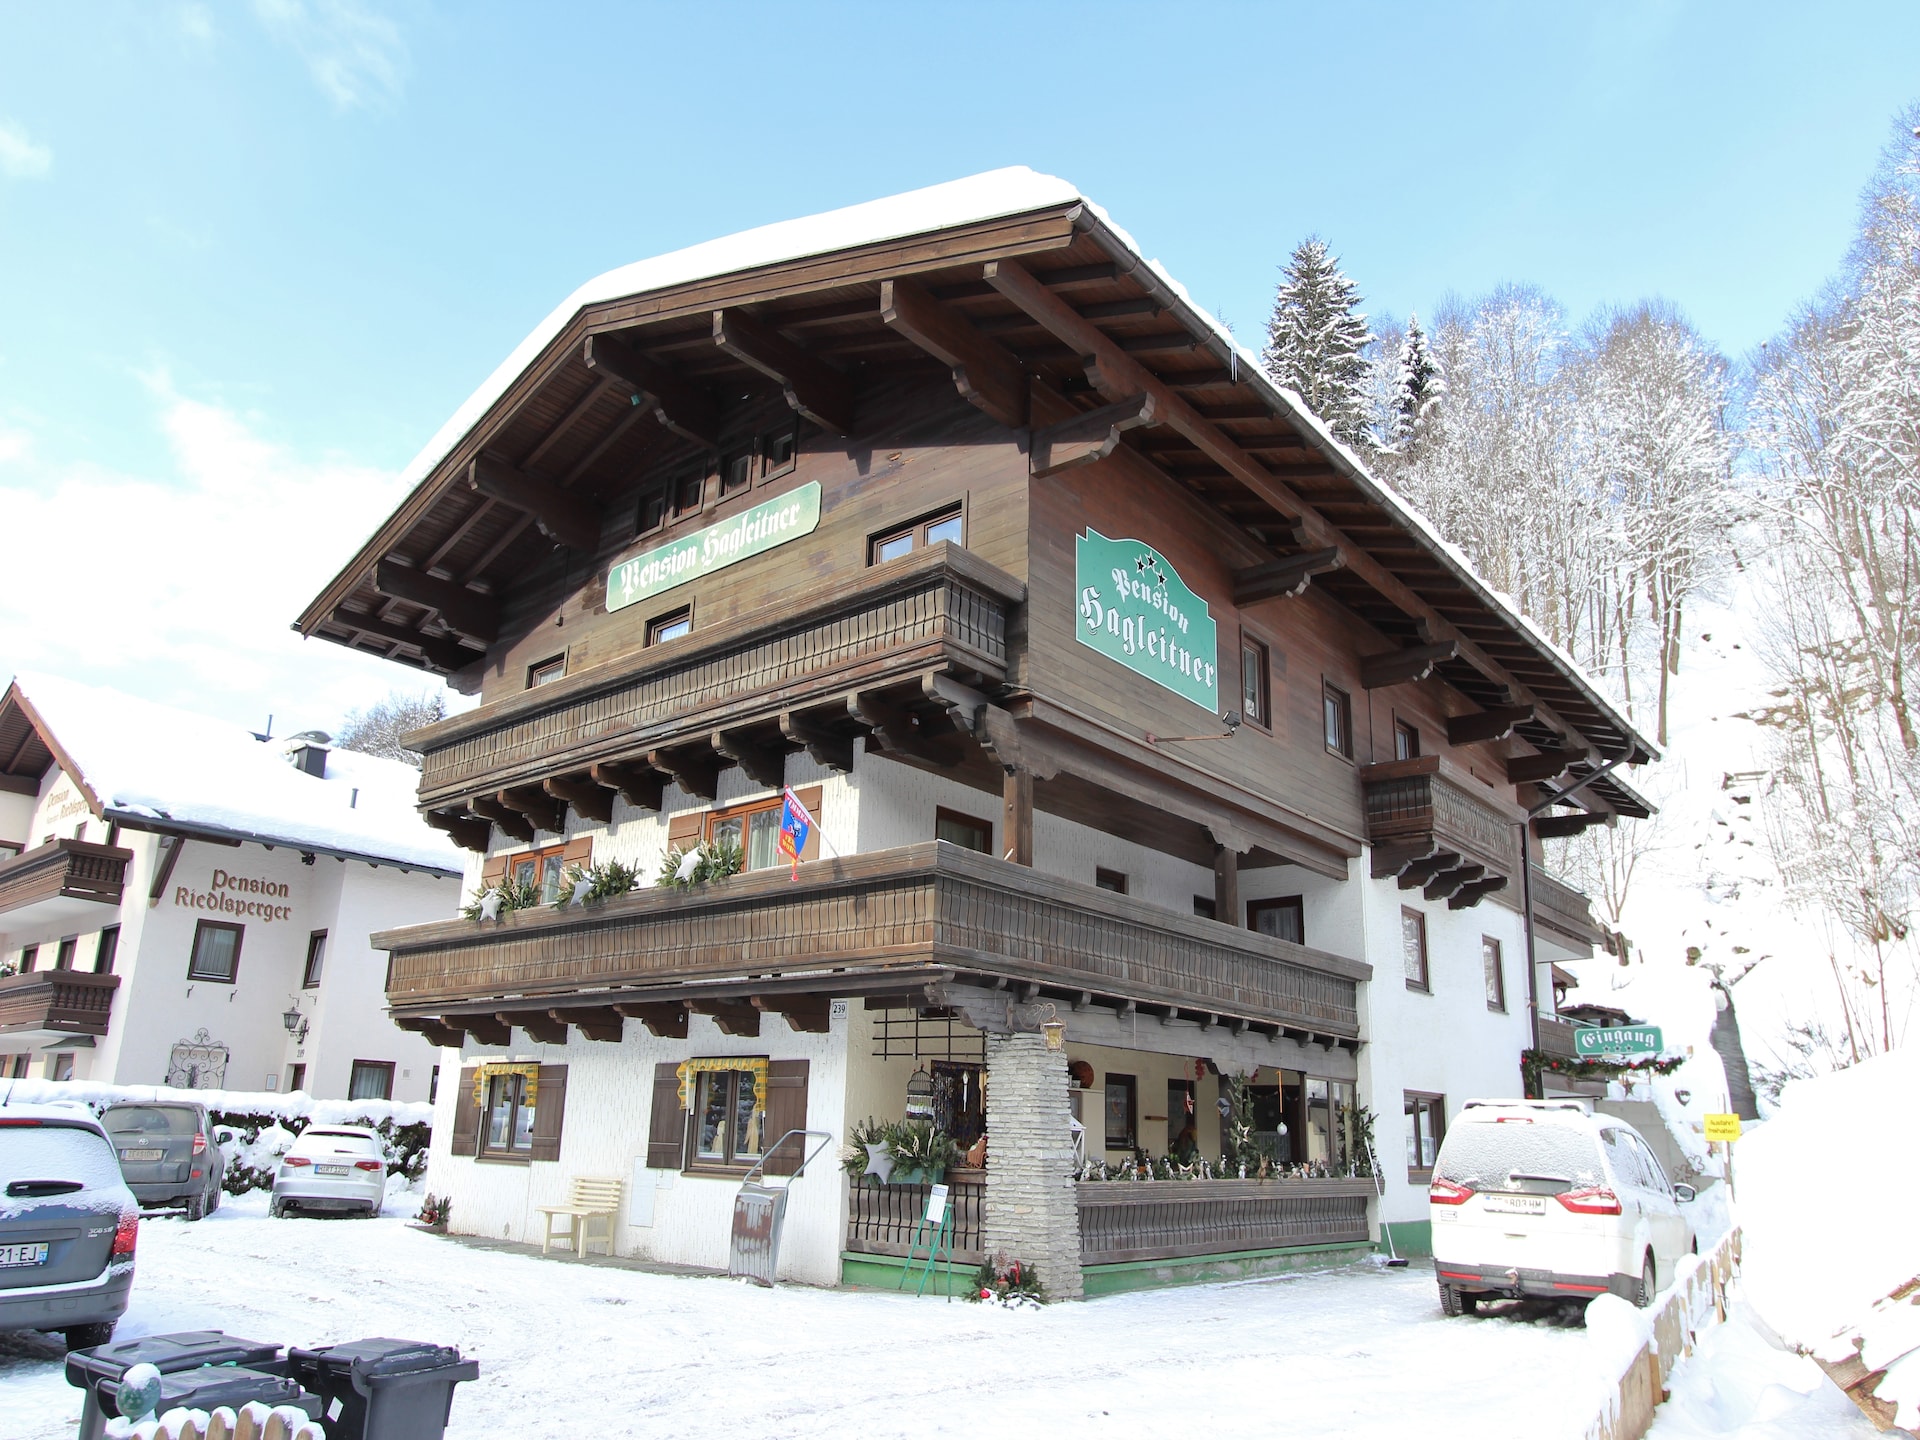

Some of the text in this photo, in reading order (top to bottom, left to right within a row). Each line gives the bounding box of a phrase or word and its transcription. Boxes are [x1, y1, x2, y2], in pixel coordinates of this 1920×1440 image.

[620, 502, 801, 603] Pension Hagleitner
[1112, 568, 1189, 634] Pension
[1080, 586, 1214, 688] Hagleitner
[211, 869, 289, 898] Pension
[175, 886, 292, 922] Riedlsperger
[834, 1004, 846, 1013] 239
[1581, 1030, 1655, 1048] Eingang
